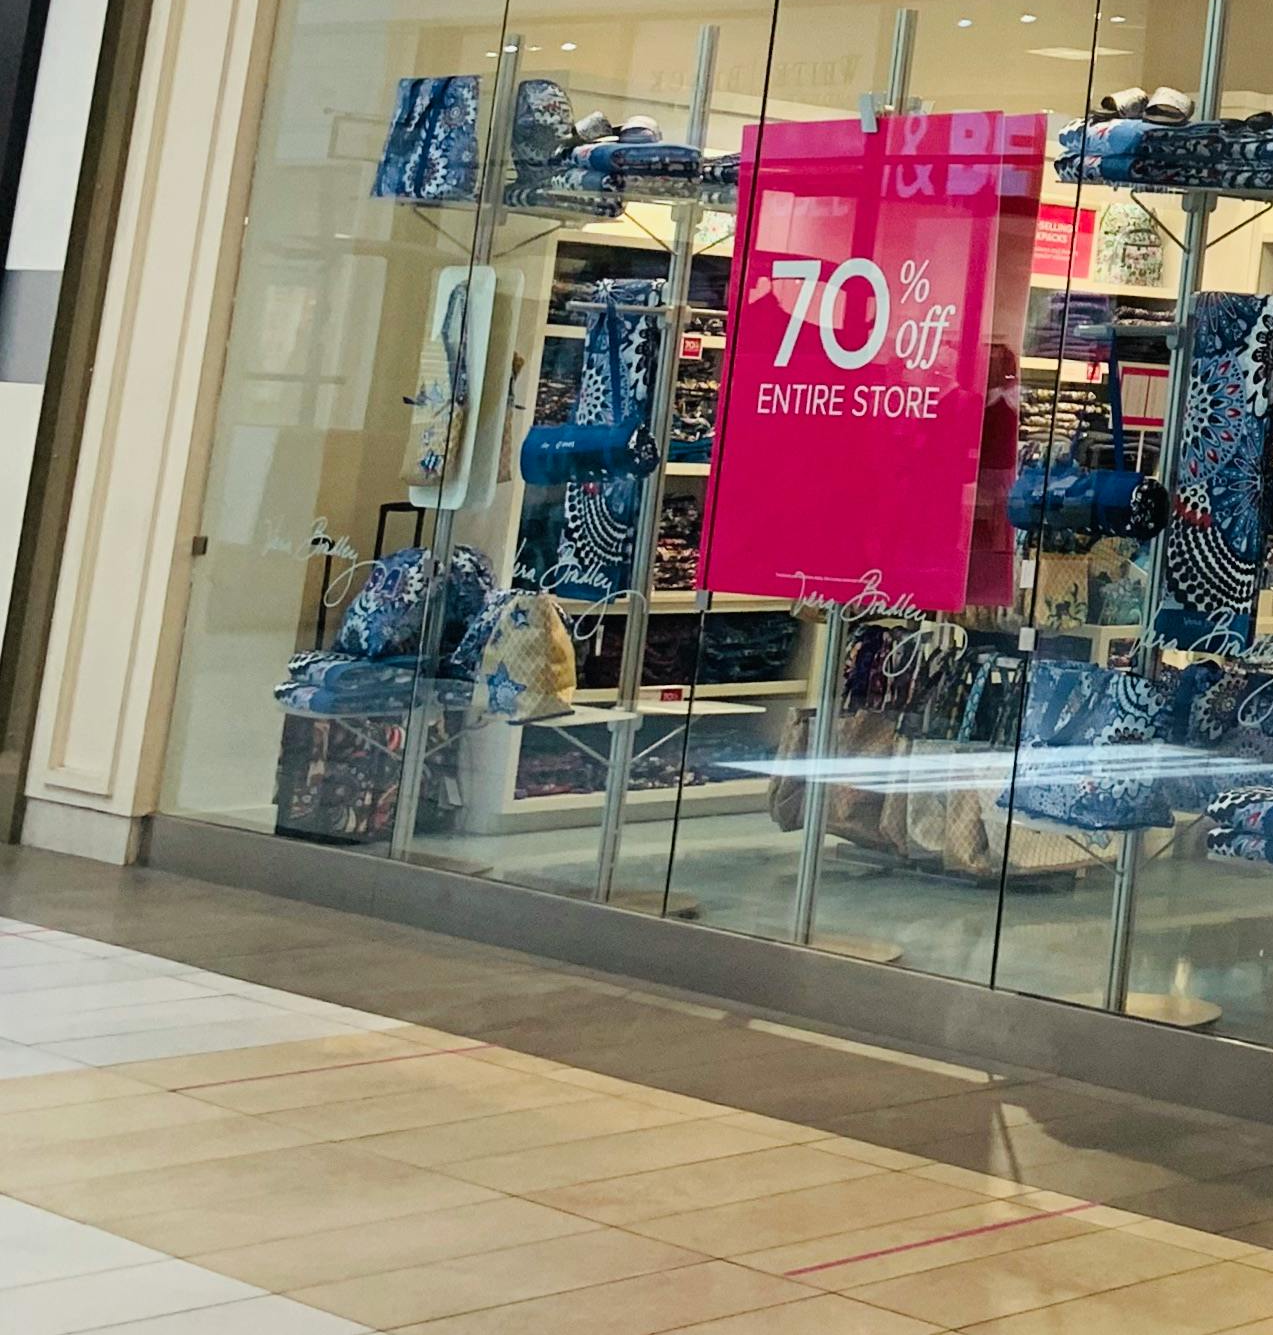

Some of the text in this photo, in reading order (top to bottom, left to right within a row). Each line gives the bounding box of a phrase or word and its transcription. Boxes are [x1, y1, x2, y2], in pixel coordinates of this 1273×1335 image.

[895, 304, 957, 370] off
[757, 383, 941, 419] ENTIRE STORE
[539, 541, 648, 641] Bradley
[839, 568, 969, 678] Bradley
